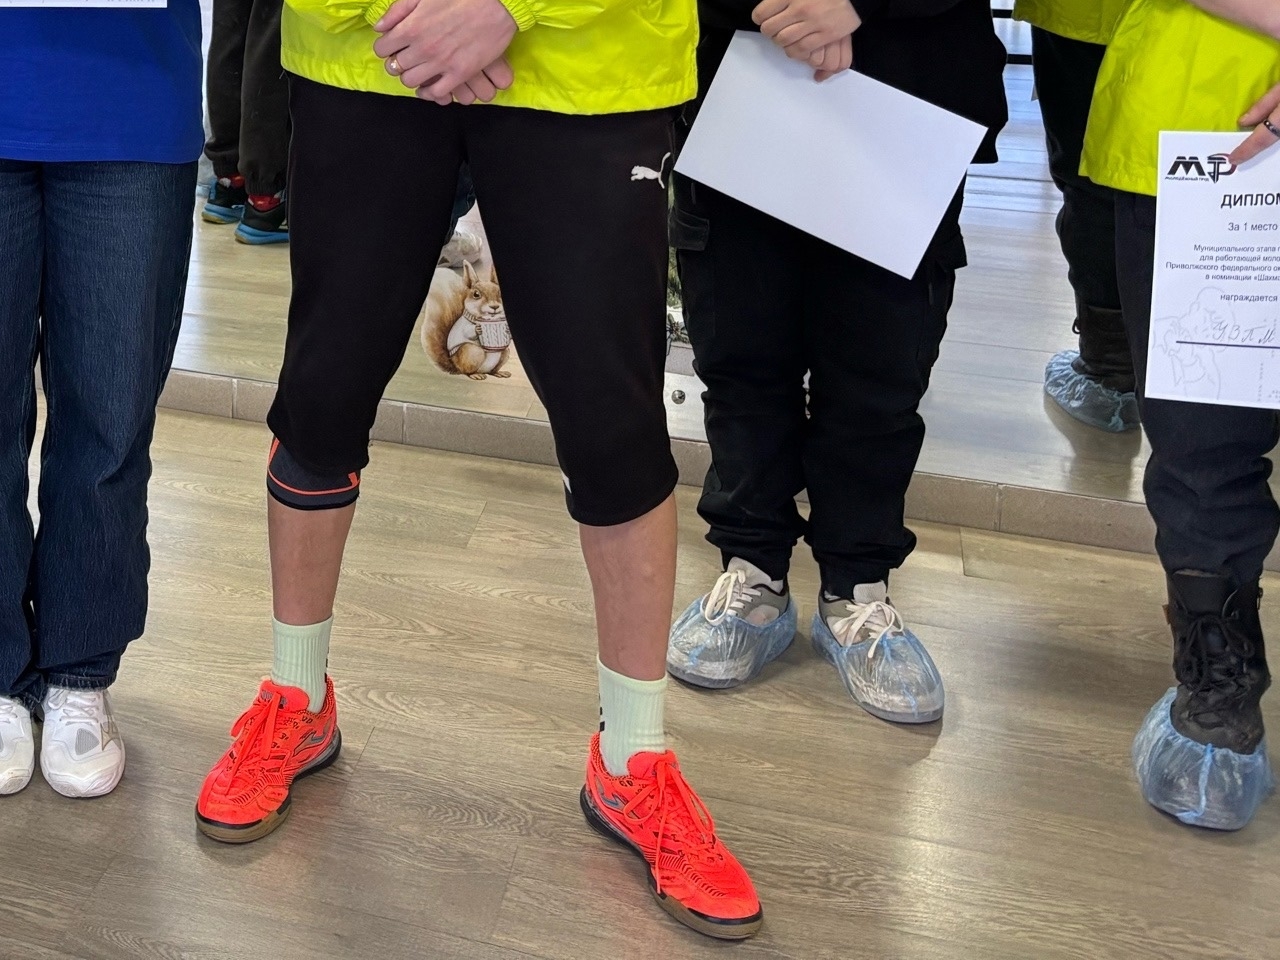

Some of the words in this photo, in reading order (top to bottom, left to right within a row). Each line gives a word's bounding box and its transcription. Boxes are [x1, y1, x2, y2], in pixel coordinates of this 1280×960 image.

[1228, 222, 1240, 231] За
[1244, 222, 1248, 231] 1
[1251, 223, 1278, 231] место
[1194, 244, 1255, 253] Муниципального
[1215, 254, 1261, 262] работающей
[1165, 261, 1219, 271] Приволжского
[1220, 264, 1272, 272] федерального
[1211, 274, 1252, 282] номинации
[1220, 294, 1278, 303] награждается
